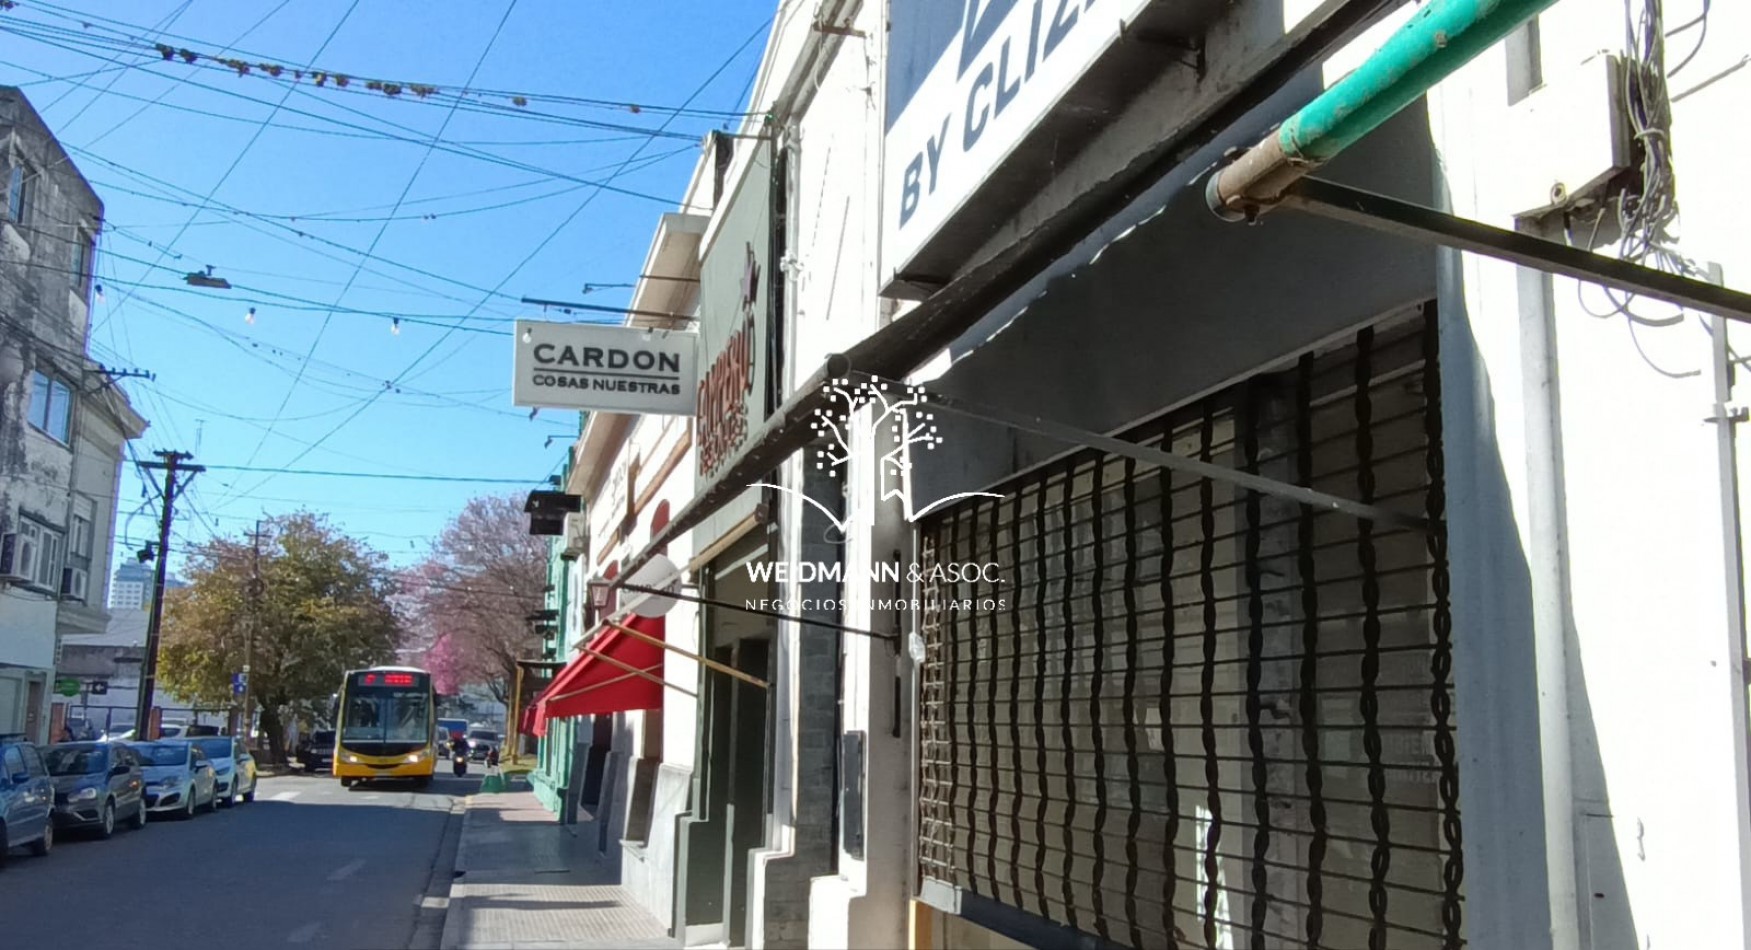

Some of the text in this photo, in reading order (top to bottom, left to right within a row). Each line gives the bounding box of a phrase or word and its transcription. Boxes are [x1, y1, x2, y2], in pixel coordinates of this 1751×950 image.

[899, 113, 952, 231] BY
[963, 0, 1098, 152] CLIZ
[533, 343, 681, 372] CARDON
[532, 374, 681, 395] COSAS NUESTRAS
